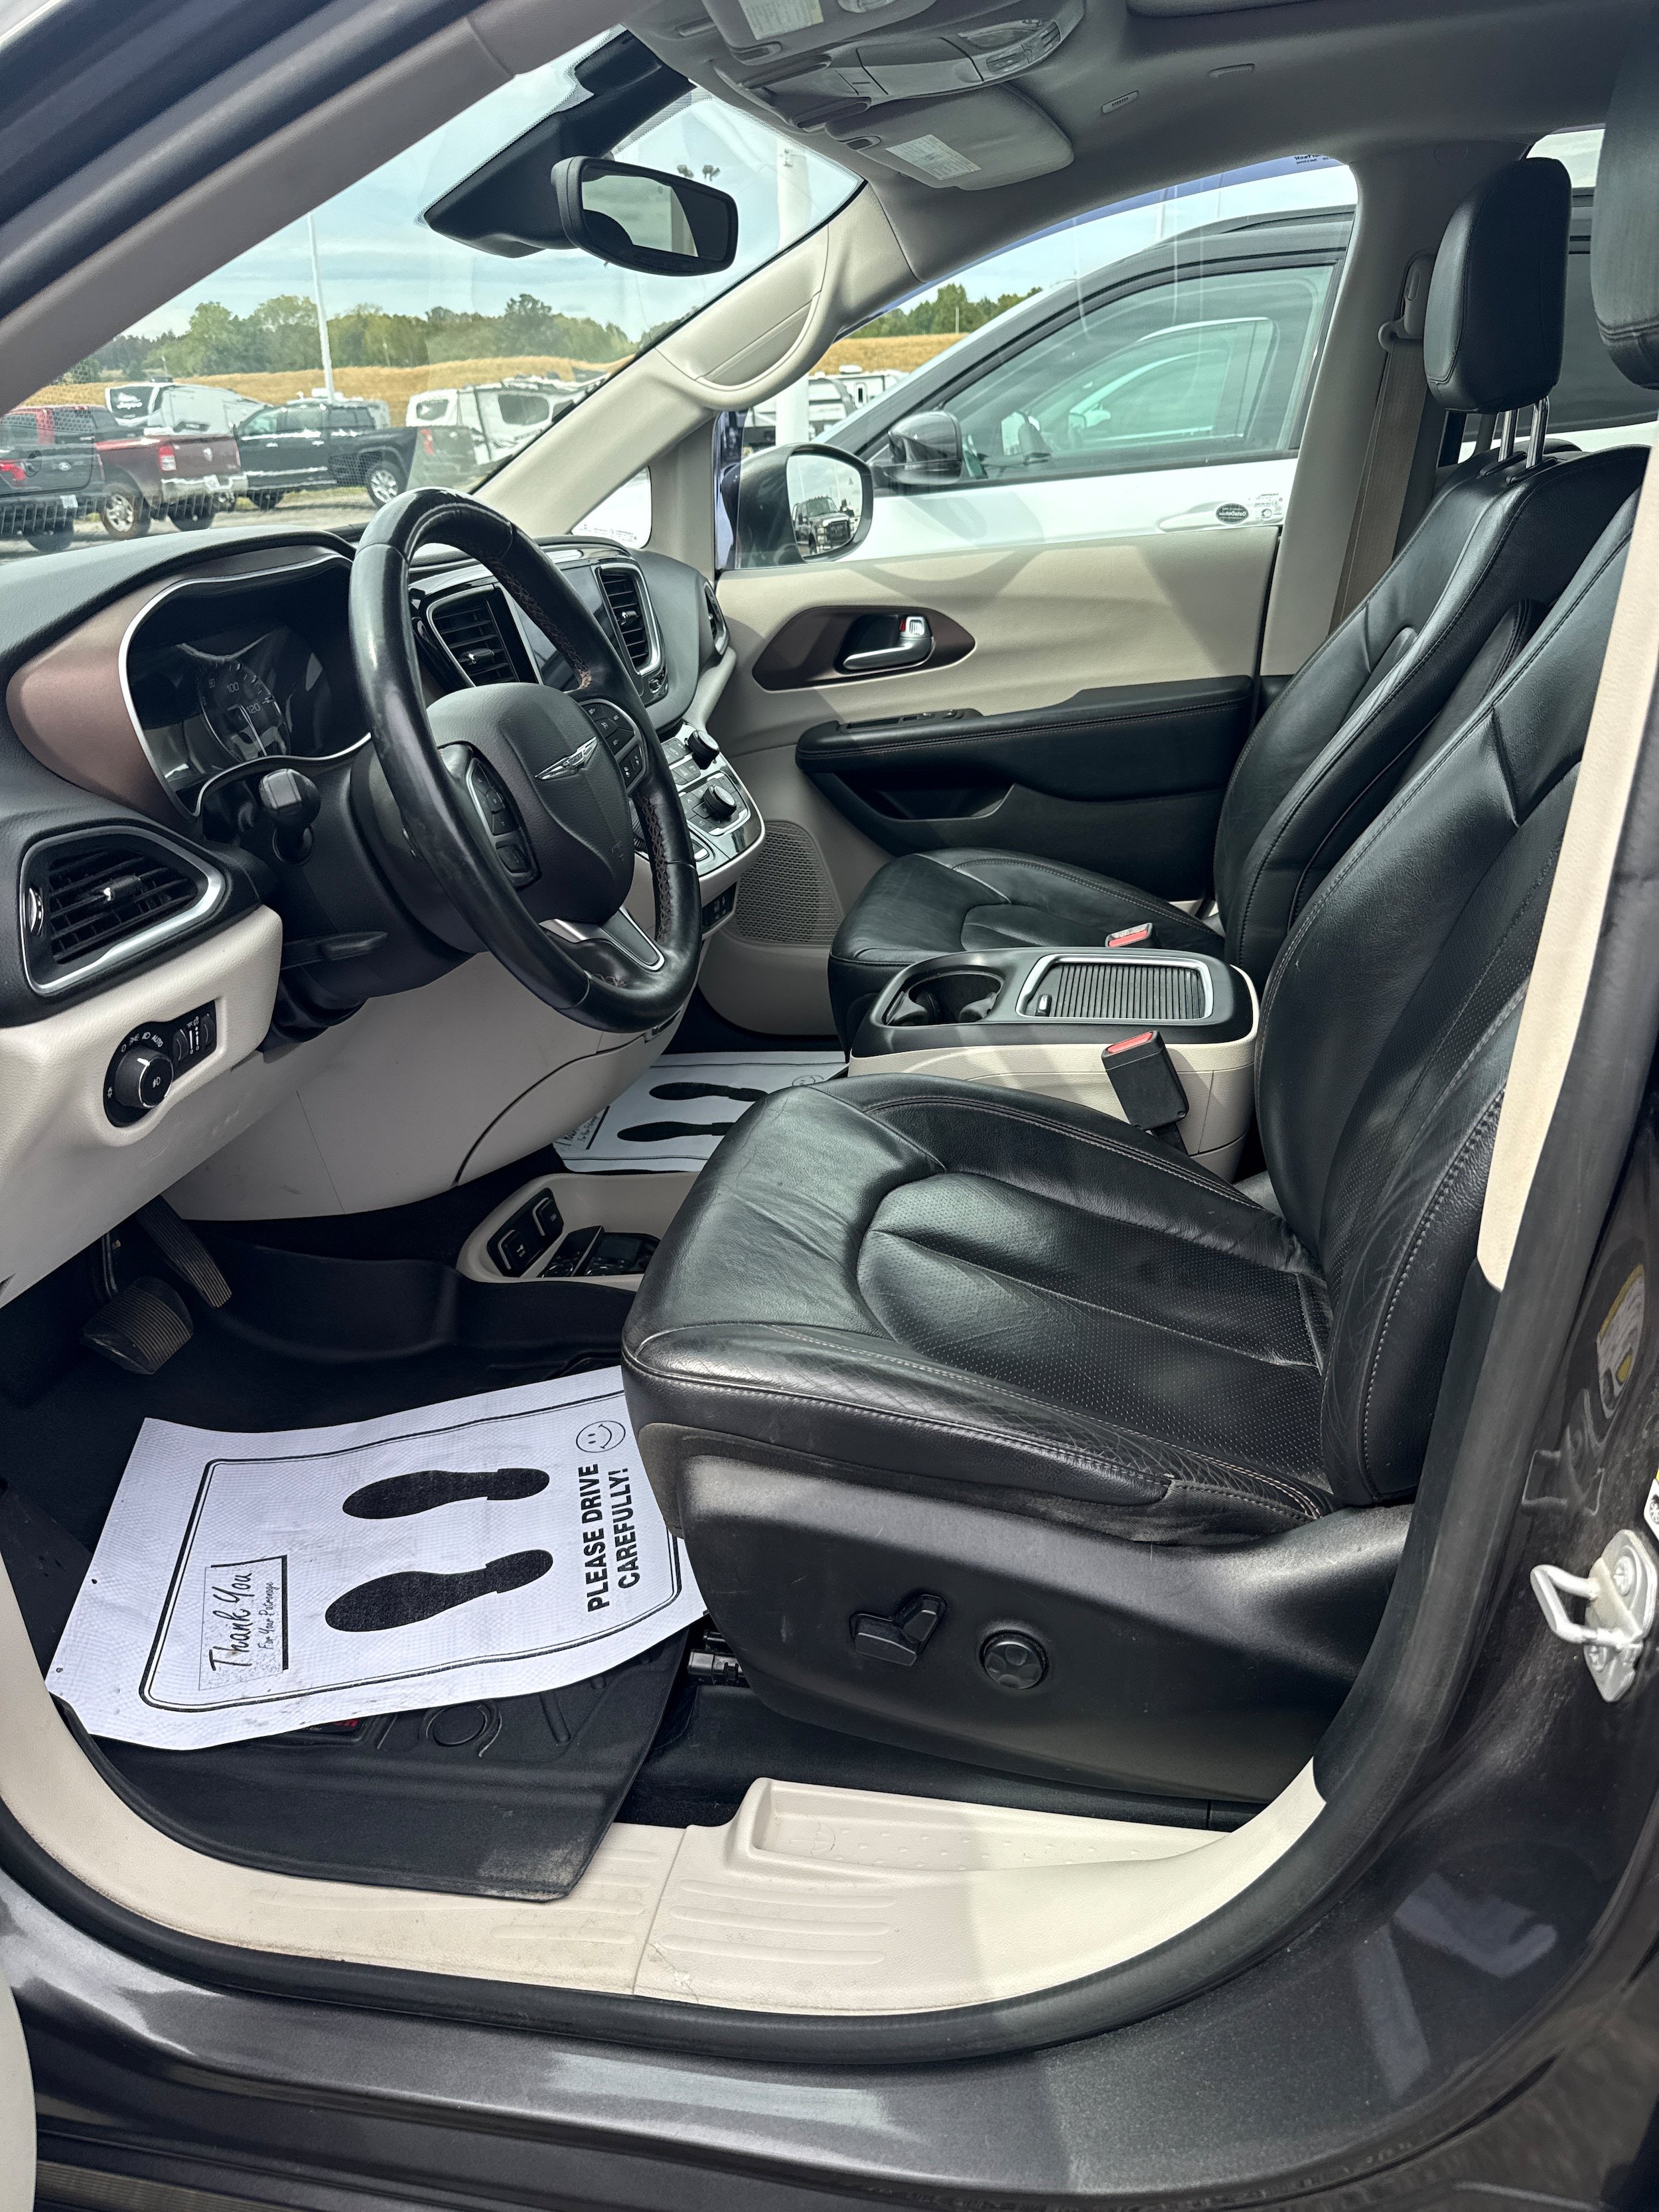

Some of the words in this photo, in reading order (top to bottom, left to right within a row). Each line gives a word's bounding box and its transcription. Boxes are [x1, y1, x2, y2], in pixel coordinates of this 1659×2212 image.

[226, 682, 240, 694] 100
[246, 703, 261, 714] 120
[151, 1034, 164, 1047] AUTO
[578, 1463, 603, 1524] DRIVE
[608, 1468, 640, 1589] CAREFULLY!
[583, 1528, 610, 1612] PLEASE
[211, 1573, 255, 1603] You
[258, 1582, 280, 1617] Patronage
[209, 1609, 253, 1671] Thank
[258, 1617, 275, 1634] Your
[257, 1636, 275, 1649] For
